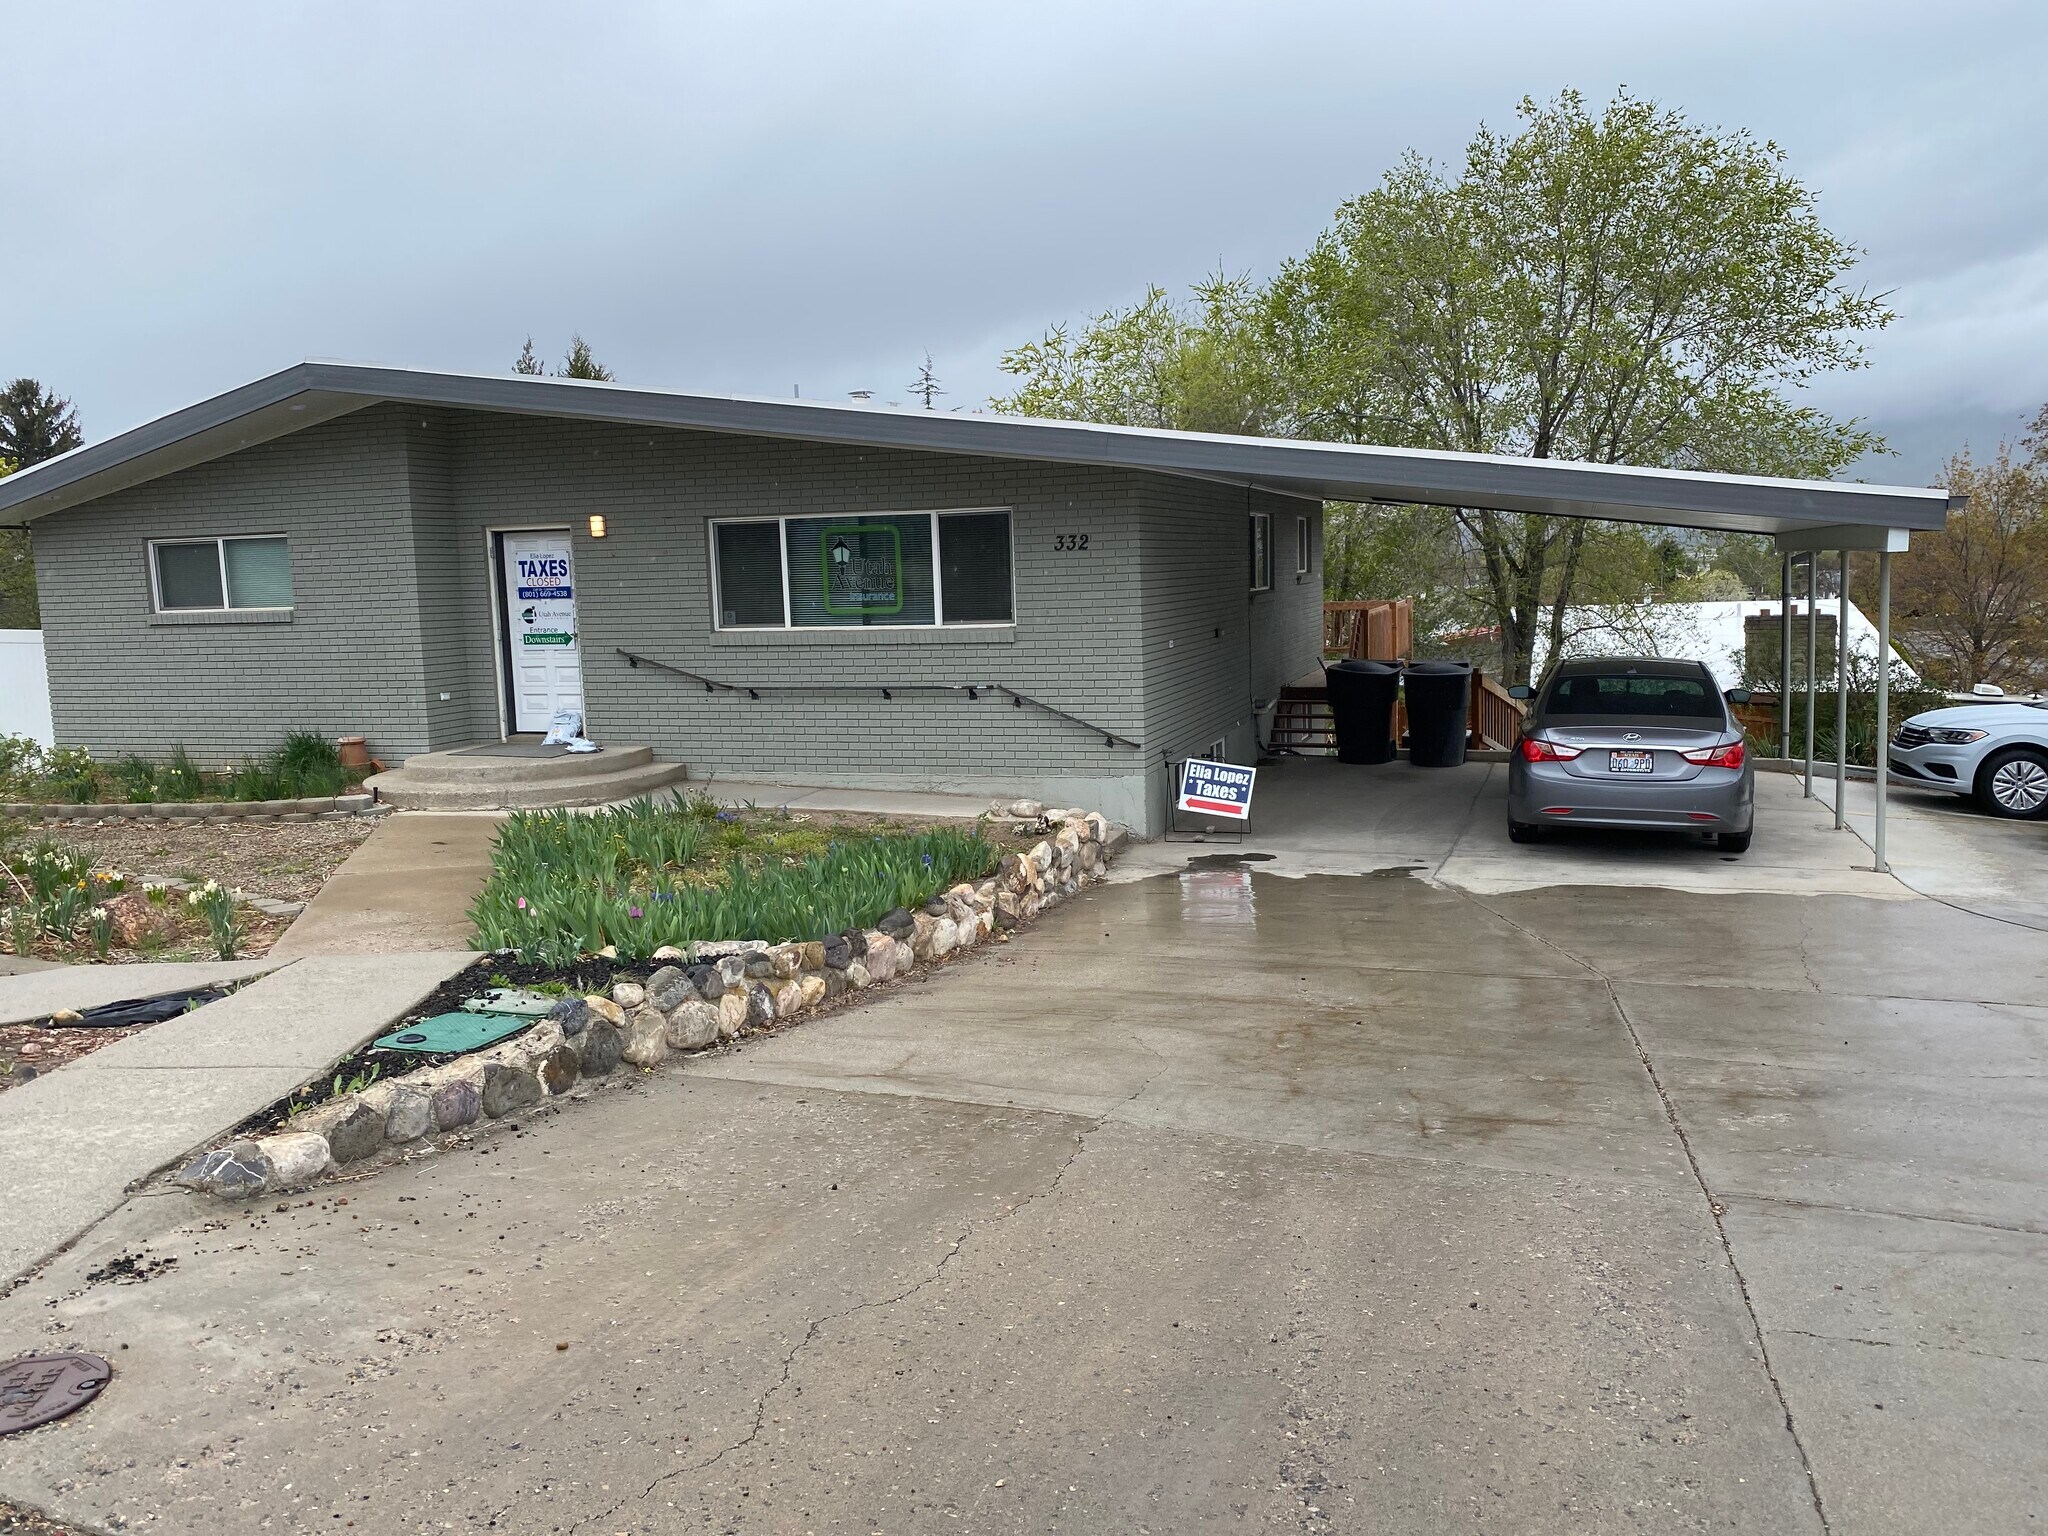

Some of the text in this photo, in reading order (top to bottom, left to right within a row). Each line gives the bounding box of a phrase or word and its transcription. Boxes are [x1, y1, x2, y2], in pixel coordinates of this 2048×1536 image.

[1054, 534, 1089, 551] 332
[518, 559, 567, 577] TAXES
[851, 558, 893, 575] Utah
[526, 577, 561, 587] CLOSED
[831, 573, 895, 590] Avenue
[522, 591, 539, 599] (801)
[525, 635, 566, 644] Downstairs
[1189, 764, 1250, 785] Elia Lopez
[1195, 780, 1238, 800] Taxes
